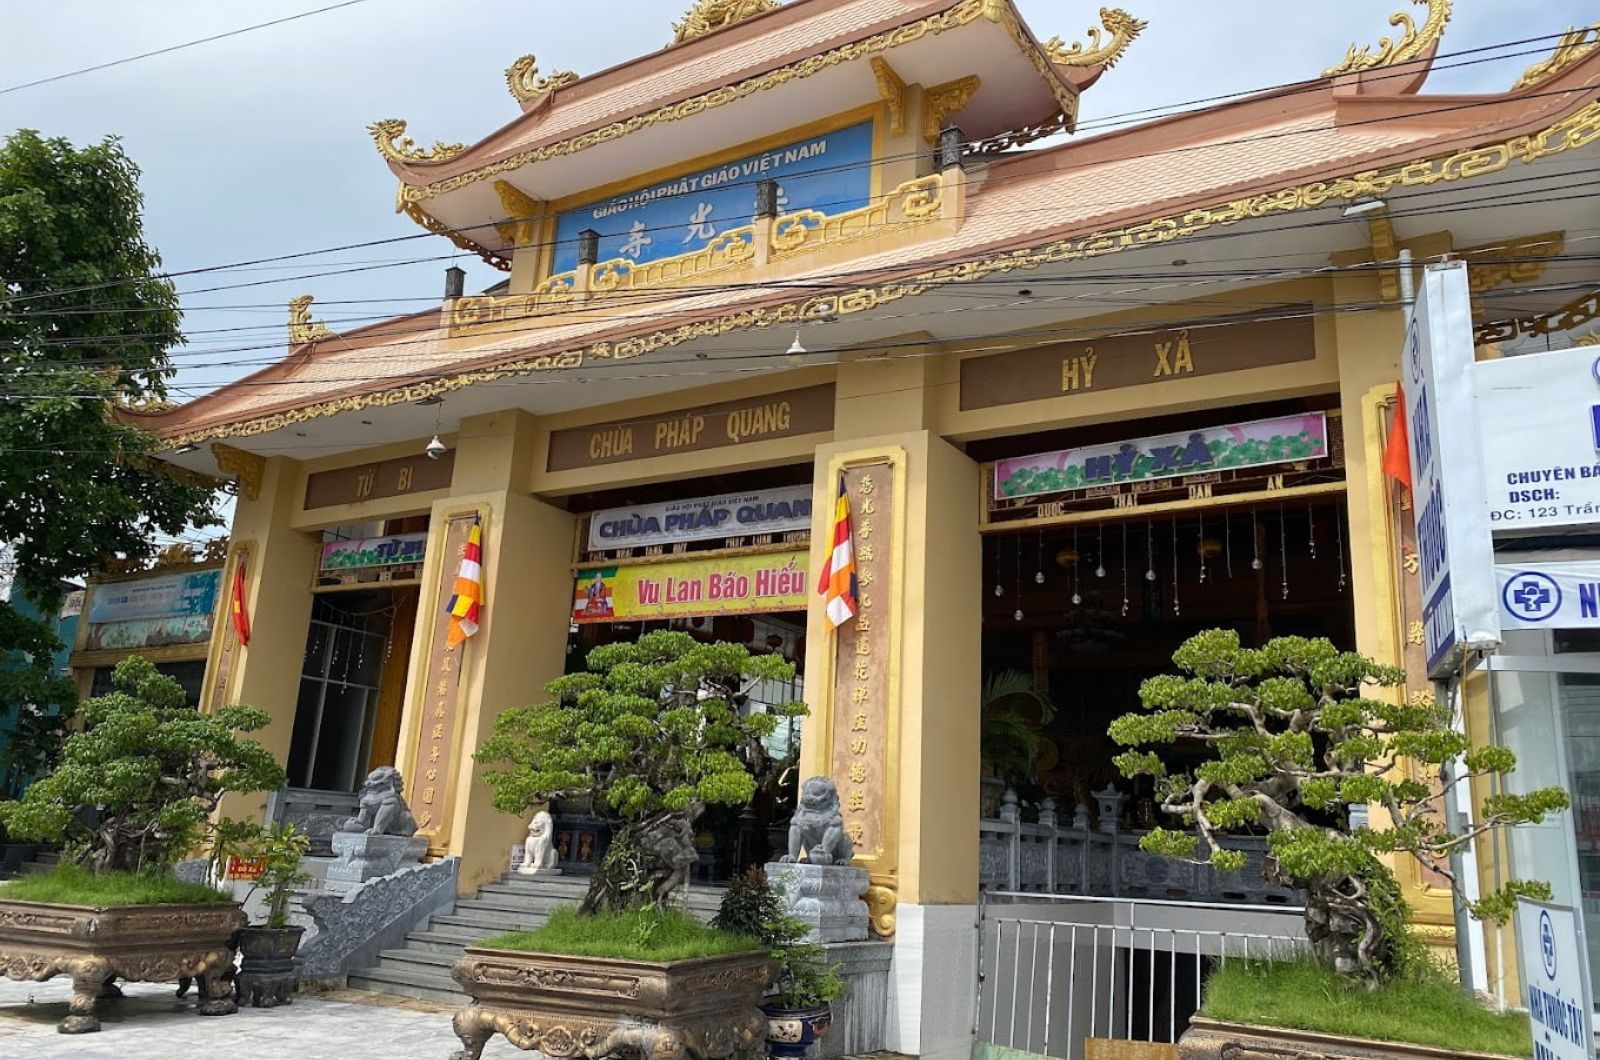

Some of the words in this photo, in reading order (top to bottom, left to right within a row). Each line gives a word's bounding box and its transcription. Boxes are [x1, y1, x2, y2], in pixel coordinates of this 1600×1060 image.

[593, 198, 628, 219] GIÁO
[628, 189, 656, 210] HỘI
[656, 177, 700, 200] PHẬT
[702, 166, 740, 188] GIÁO
[743, 152, 784, 175] VIỆT
[785, 140, 827, 164] NAM
[1062, 346, 1098, 391] HỶ
[1153, 329, 1194, 377] XẢ
[590, 424, 633, 460] CHÙA
[655, 413, 705, 450] PHÁP
[726, 401, 791, 443] QUANG
[1085, 444, 1142, 481] HỶ
[1149, 432, 1215, 472] XẢ
[1507, 466, 1575, 485] CHUYÊN
[397, 466, 414, 491] BI
[1509, 488, 1560, 503] DSCH:
[600, 513, 661, 538] CHÙA
[665, 503, 731, 532] PHÁP
[1490, 509, 1521, 521] ĐC:
[1528, 506, 1558, 518] 123
[638, 578, 661, 605] Vu
[665, 576, 702, 604] Lan
[708, 571, 748, 600] Báo
[755, 555, 806, 598] Hiếu
[1579, 583, 1600, 619] N
[1528, 980, 1546, 1025] NHÀ
[1541, 987, 1569, 1040] THUỐC
[1566, 998, 1585, 1050] TÂY
